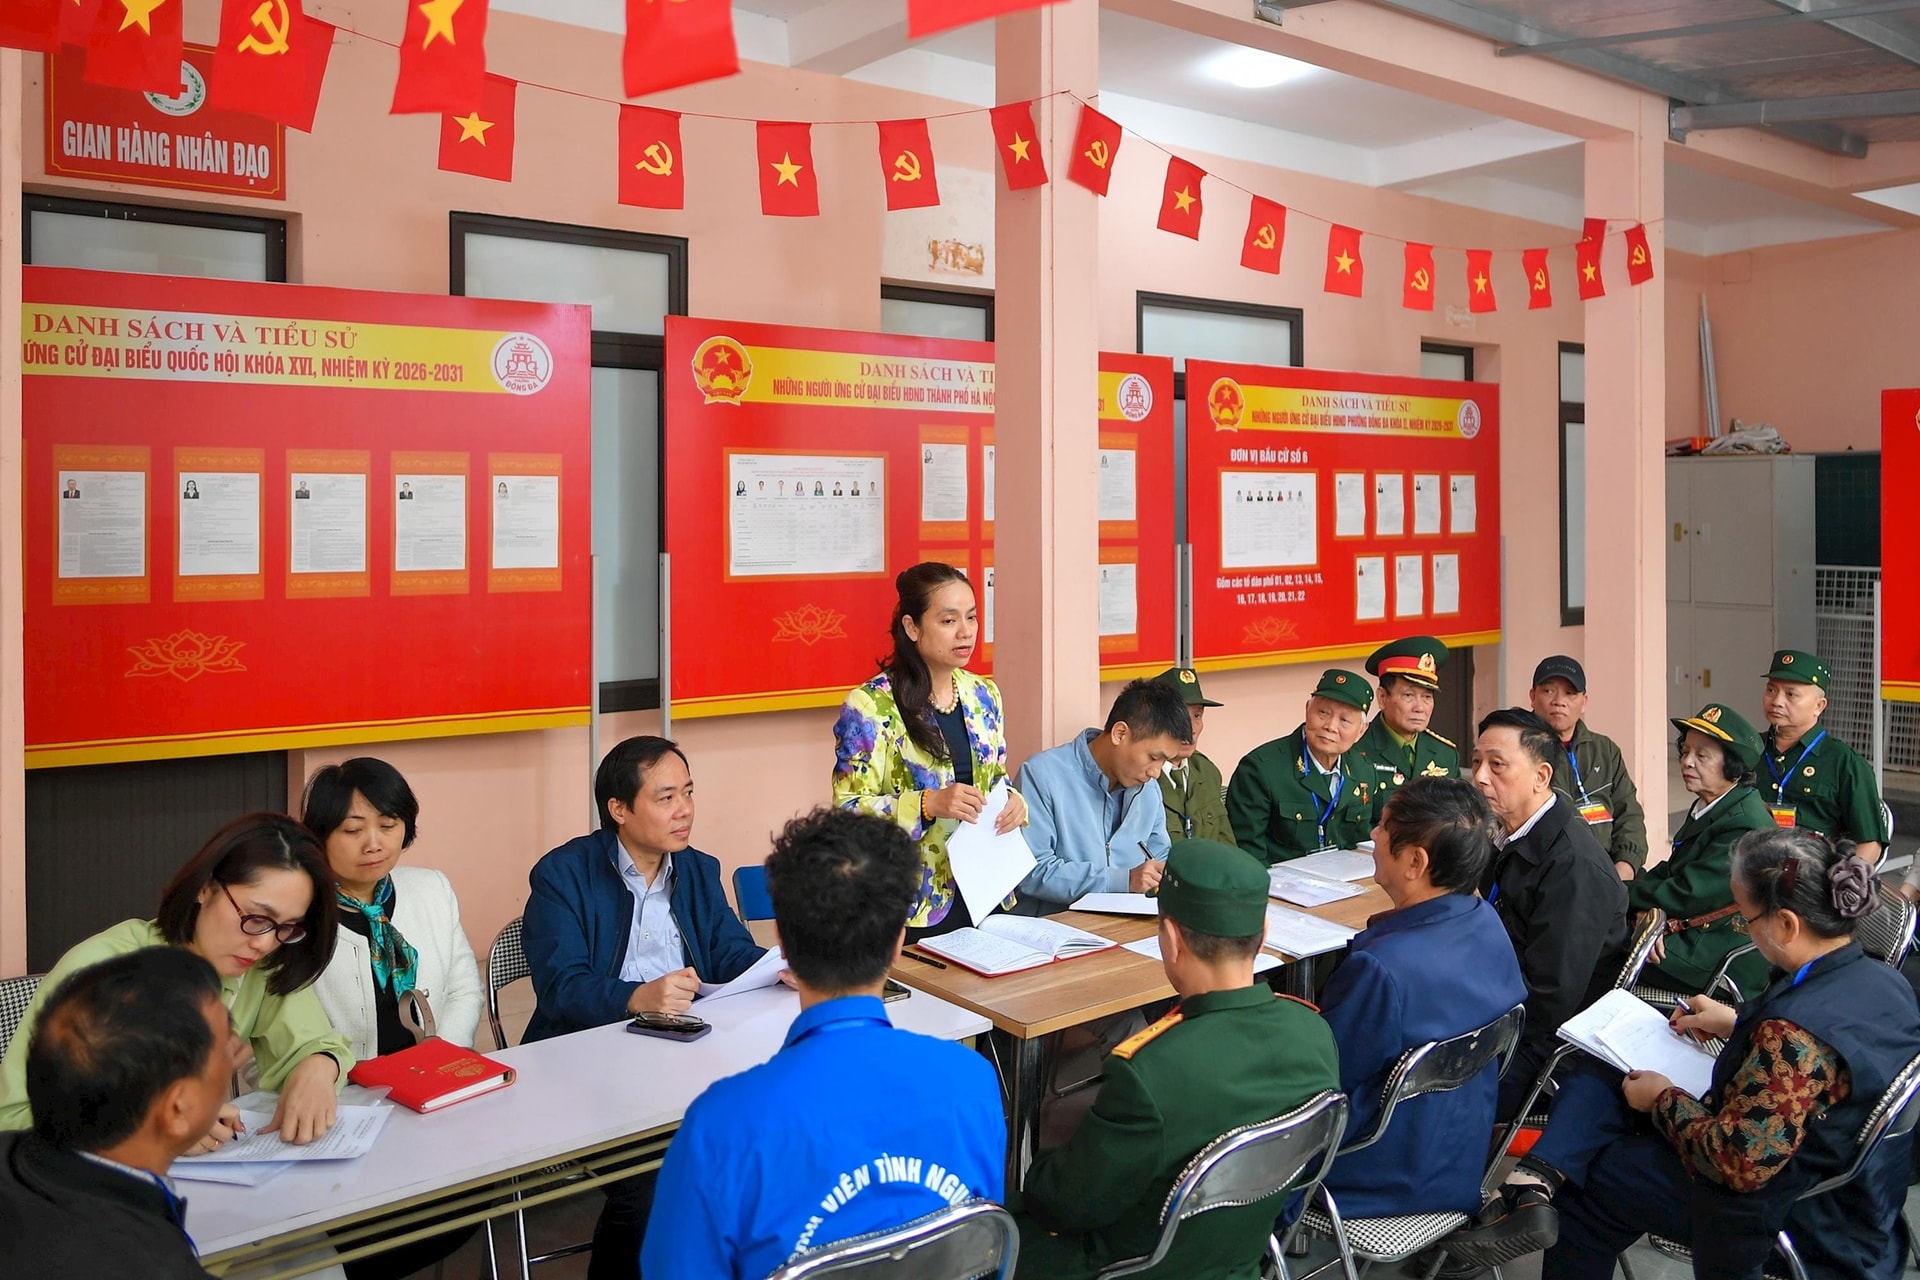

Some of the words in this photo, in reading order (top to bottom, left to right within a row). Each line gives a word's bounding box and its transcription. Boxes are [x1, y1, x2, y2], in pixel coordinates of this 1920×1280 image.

[63, 120, 111, 161] GIAN
[117, 121, 170, 167] HÀNG
[176, 131, 228, 174] NHÂN
[233, 142, 270, 185] ĐẠO
[33, 313, 119, 337] DANH
[127, 316, 205, 341] SÁCH
[213, 320, 247, 343] VÀ
[255, 321, 317, 347] TIỂU
[324, 326, 358, 349] SỬ
[23, 339, 59, 365] ỨNG
[65, 338, 88, 366] CỬ
[92, 346, 119, 372] ĐẠI
[125, 341, 162, 370] BIỂU
[167, 344, 209, 372] QUỐC
[214, 349, 239, 377] HỘI
[244, 349, 285, 375] KHÓA
[289, 355, 317, 378] XVI,
[321, 355, 368, 382] NHIỆM
[373, 357, 391, 380] KỲ
[394, 361, 464, 383] 2026-2031
[860, 361, 906, 379] DANH
[910, 363, 951, 382] SÁCH
[956, 365, 975, 383] VÀ
[979, 370, 995, 384] TI
[773, 376, 803, 396] NHỮNG
[806, 378, 832, 398] NGƯỜI
[835, 379, 852, 399] ỨNG
[854, 379, 866, 400] CỬ
[867, 385, 880, 404] ĐẠI
[883, 380, 901, 401] BIỂU
[904, 388, 924, 403] HĐND
[927, 385, 952, 404] THÀNH
[953, 384, 969, 405] PHỐ
[971, 388, 981, 405] HÀ
[1302, 395, 1330, 408] DANH
[1332, 394, 1359, 409] SÁCH
[1361, 396, 1373, 410] VÀ
[1376, 397, 1396, 411] TIỂU
[1399, 399, 1411, 412] SỬ
[1230, 448, 1248, 462] ĐƠN
[1250, 449, 1258, 465] VỊ
[1260, 446, 1276, 463] BẦU
[1277, 446, 1290, 463] CỬ
[1290, 446, 1301, 463] SỐ
[1302, 451, 1308, 463] 6
[1216, 576, 1231, 589] Gồm
[1231, 576, 1243, 588] các
[1244, 574, 1250, 587] tổ
[1251, 575, 1262, 587] dân
[1263, 573, 1274, 588] phố
[1275, 575, 1284, 587] 01,
[1285, 574, 1294, 586] 02,
[1305, 573, 1313, 585] 14,
[1237, 594, 1246, 605] 16,
[1247, 593, 1257, 604] 17,
[1278, 591, 1287, 603] 20,
[1287, 591, 1296, 603] 21,
[1297, 590, 1305, 602] 22
[820, 1163, 871, 1214] VIÊN
[874, 1152, 922, 1185] TÌNH
[924, 1163, 971, 1206] NGU
